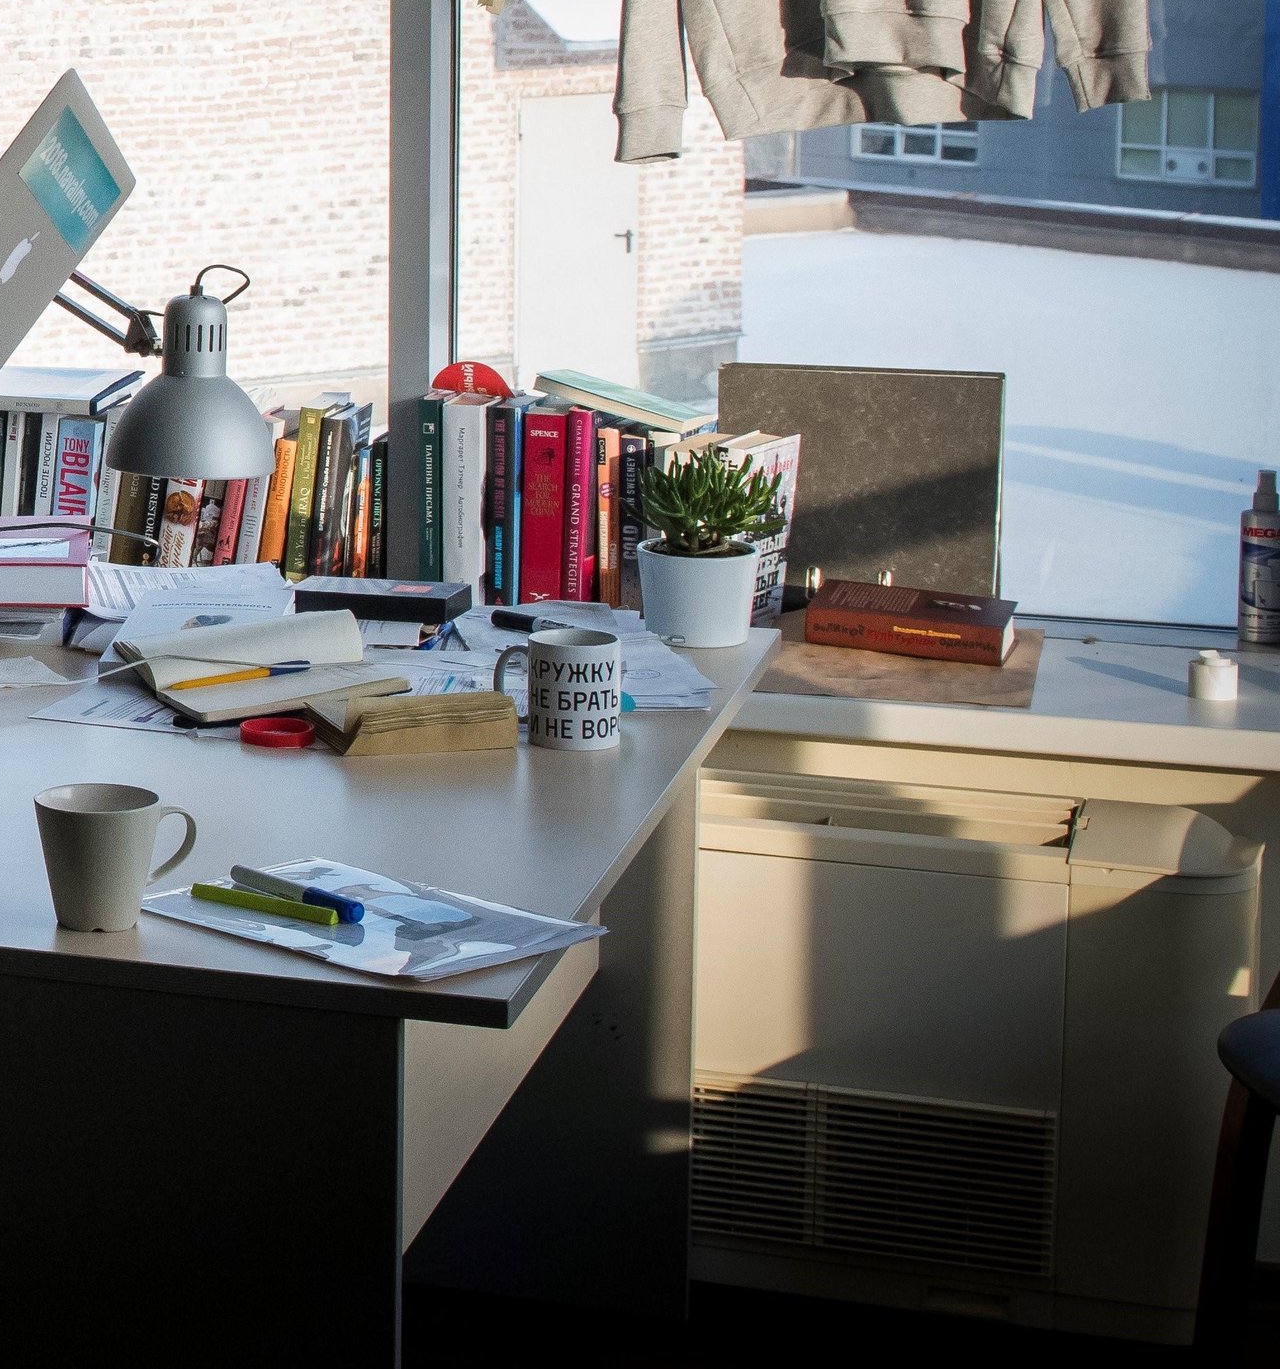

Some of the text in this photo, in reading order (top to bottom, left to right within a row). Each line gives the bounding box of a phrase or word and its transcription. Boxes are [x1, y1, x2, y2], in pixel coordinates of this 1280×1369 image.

[63, 437, 90, 453] TONY
[530, 429, 559, 438] SPENCE
[573, 419, 583, 476] CHARLES HILL
[40, 432, 53, 498] ПОСЛЕ РОССИИ
[276, 448, 291, 501] Покорность
[374, 459, 382, 498] OPPOSING
[457, 465, 465, 489] Тэтчер
[495, 419, 505, 519] THE INVENTION OF RUSSIA
[626, 457, 636, 494] SWEENEY
[527, 482, 558, 491] SEARCH
[374, 501, 382, 527] FORCES
[525, 498, 559, 509] MODERN
[294, 487, 310, 567] My Year in IRAQ
[568, 484, 582, 593] GRAND STRATEGIES
[494, 526, 503, 589] ARKADY OSTROVSKY
[531, 658, 615, 683] КРУЖКУ
[531, 689, 618, 711] НЕ БРАТЬ
[531, 717, 539, 732] И
[546, 718, 573, 740] НЕ
